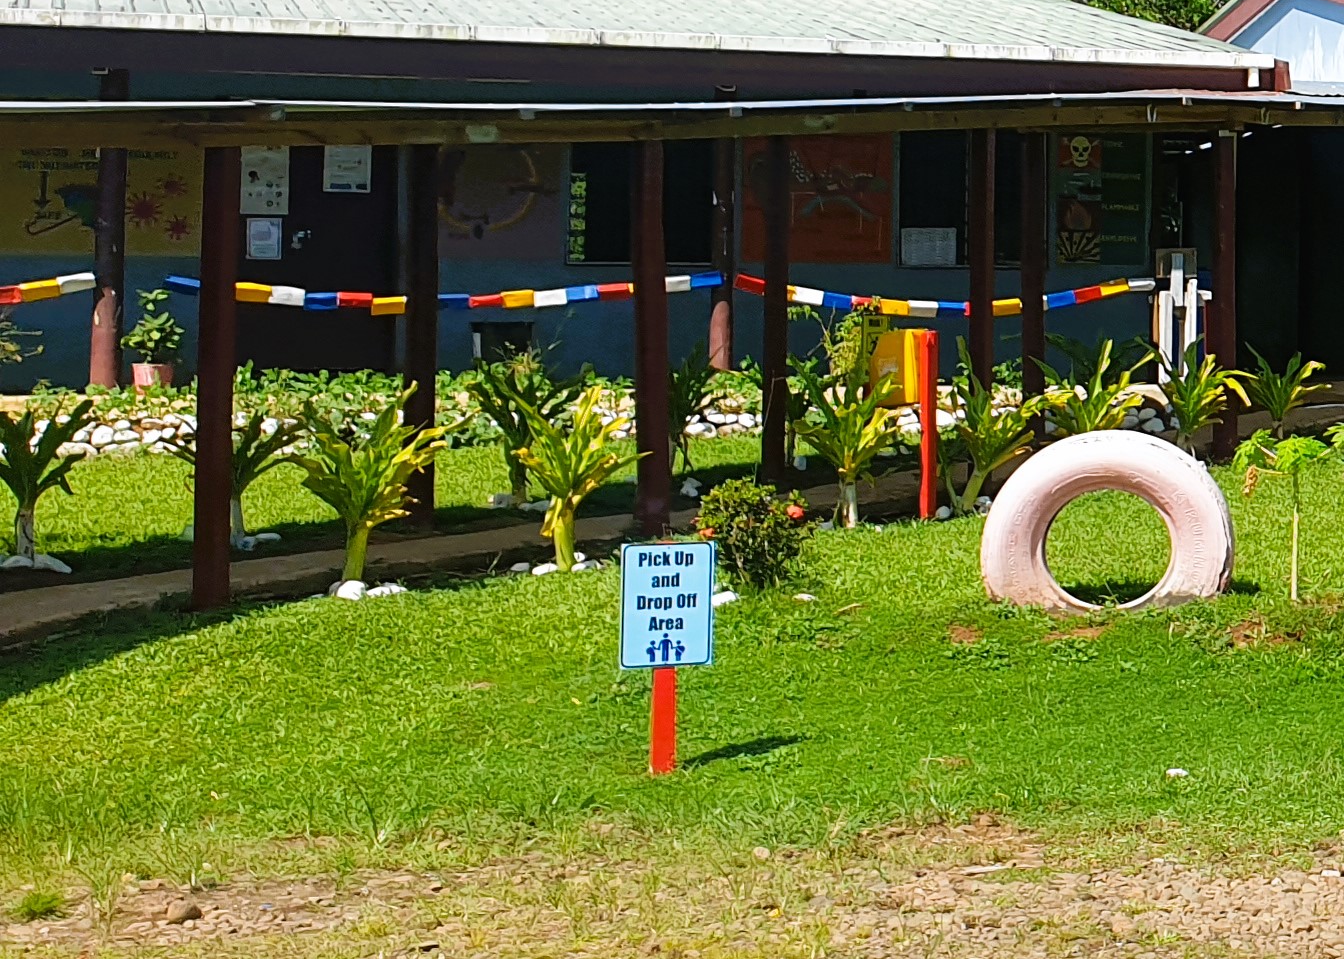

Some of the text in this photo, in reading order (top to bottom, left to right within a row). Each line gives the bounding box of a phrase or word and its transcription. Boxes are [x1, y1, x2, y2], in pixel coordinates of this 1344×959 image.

[638, 550, 694, 567] Pick Up
[651, 572, 680, 588] and
[636, 593, 697, 610] Drop Off
[648, 616, 684, 631] Area
